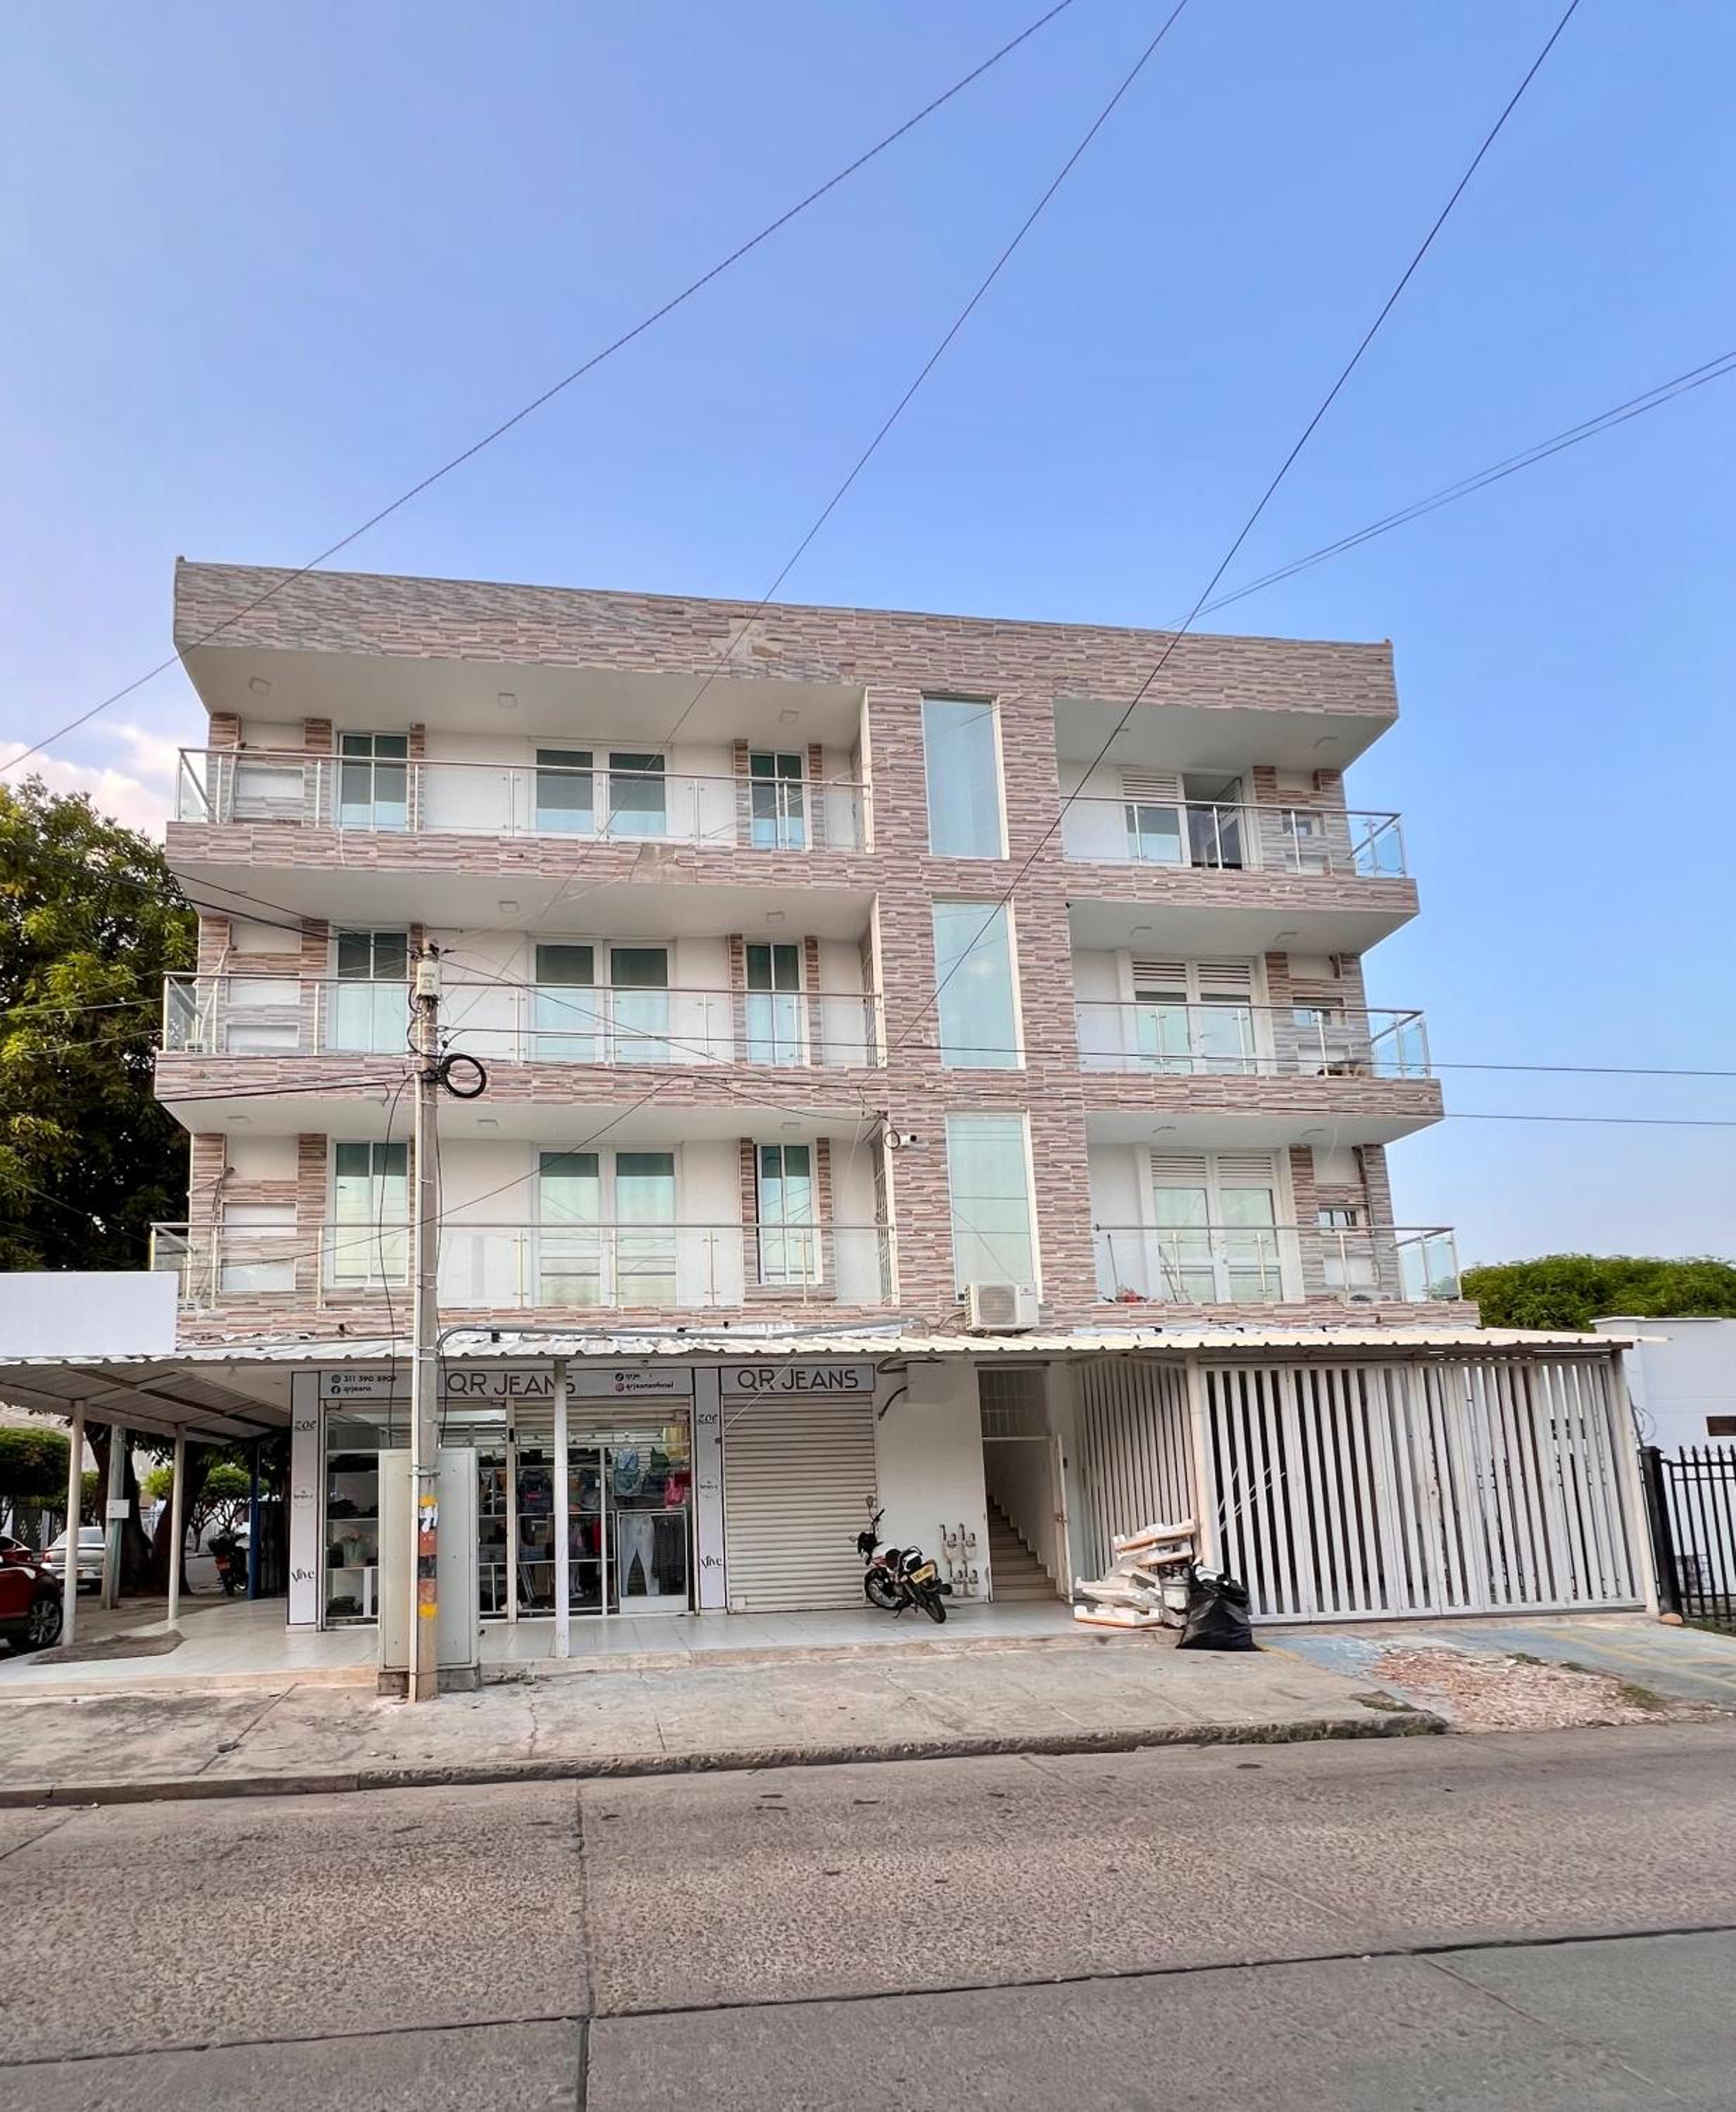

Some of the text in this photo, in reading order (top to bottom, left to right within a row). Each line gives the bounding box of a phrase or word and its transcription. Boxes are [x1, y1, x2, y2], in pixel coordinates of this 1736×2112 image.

[448, 1373, 576, 1395] QR JEANS
[738, 1369, 858, 1391] QR JEANS
